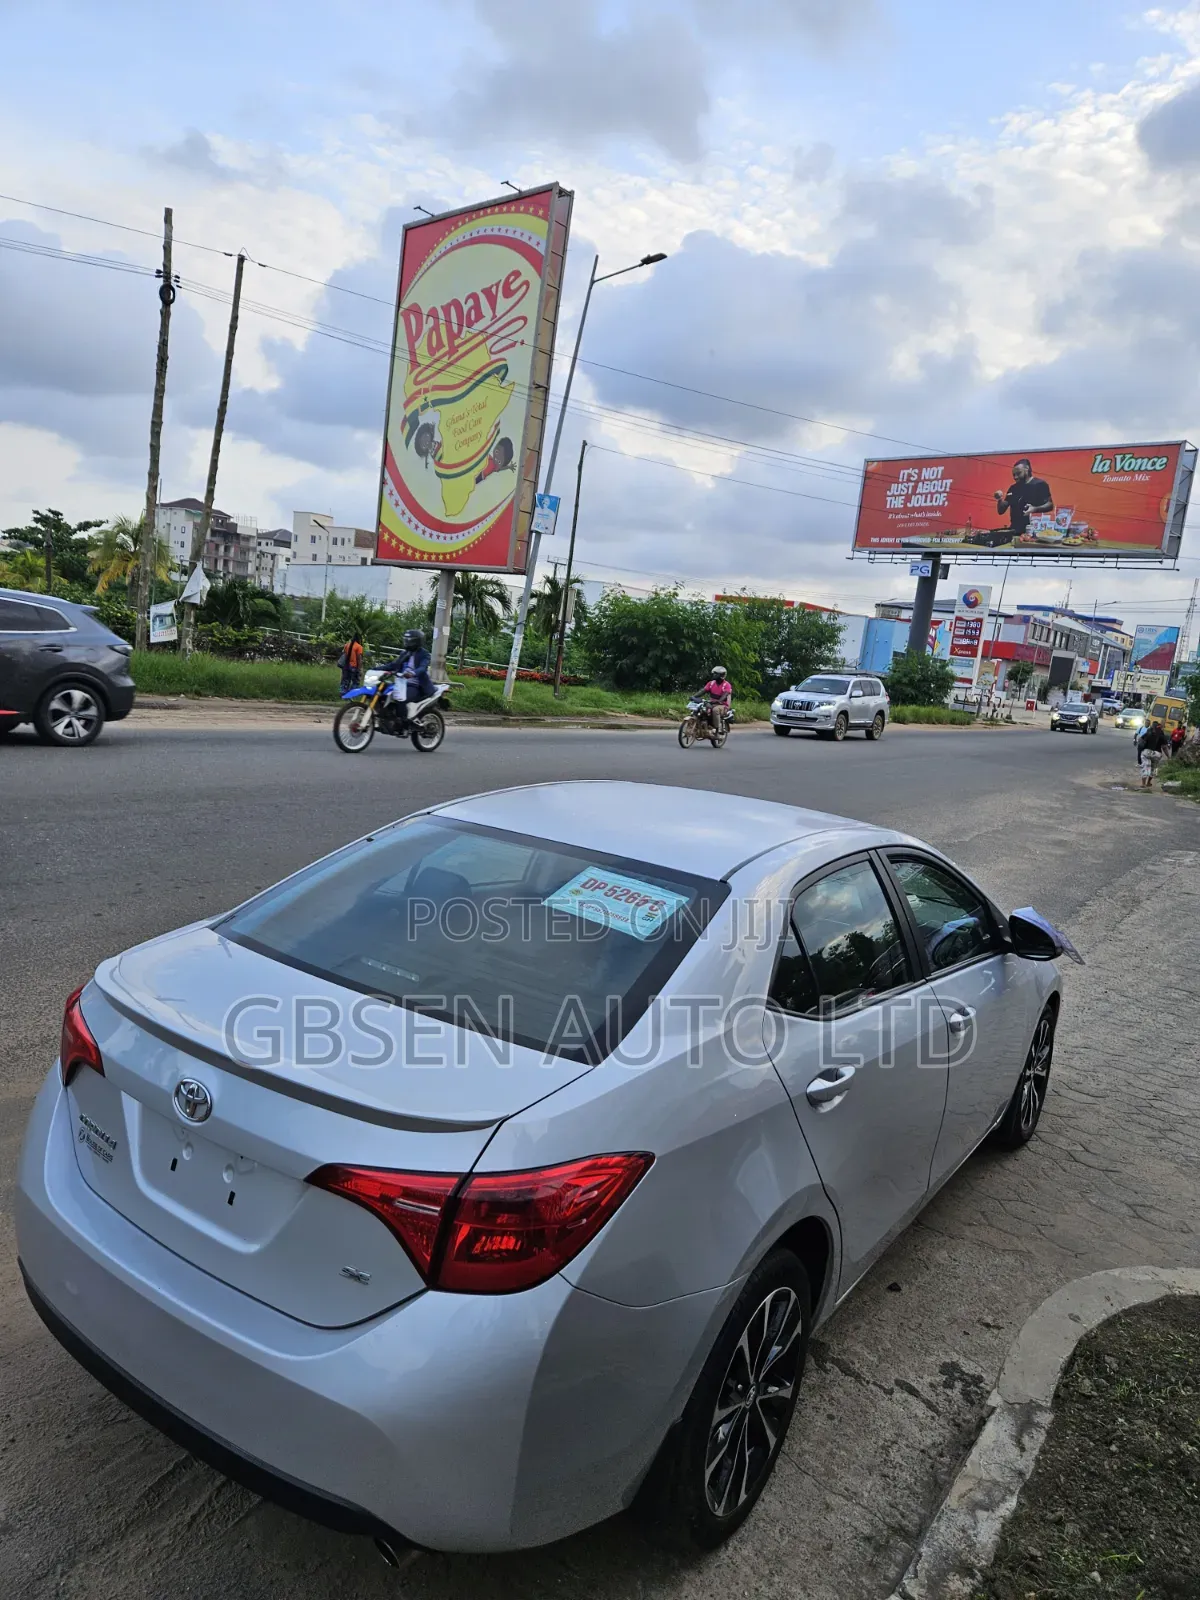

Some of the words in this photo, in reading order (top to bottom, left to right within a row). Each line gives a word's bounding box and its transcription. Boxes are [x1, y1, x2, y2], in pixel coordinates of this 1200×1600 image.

[400, 269, 530, 378] Papaye
[445, 407, 470, 428] Ghana's
[471, 396, 489, 414] Total
[452, 419, 468, 437] Food
[469, 416, 483, 430] Care
[454, 430, 482, 451] Company
[1091, 453, 1112, 474] la
[1114, 452, 1169, 473] Vonce
[899, 468, 919, 482] IT'S
[921, 467, 944, 480] NOT
[1102, 474, 1132, 483] Tomato
[1133, 473, 1152, 481] Mix
[887, 483, 914, 495] JUST
[916, 479, 953, 494] ABOUT
[886, 495, 905, 509] THE
[907, 494, 948, 508] JOLLOF,
[910, 565, 930, 575] PG
[954, 647, 971, 655] Xpress
[580, 878, 608, 892] DP
[603, 885, 653, 908] 5265
